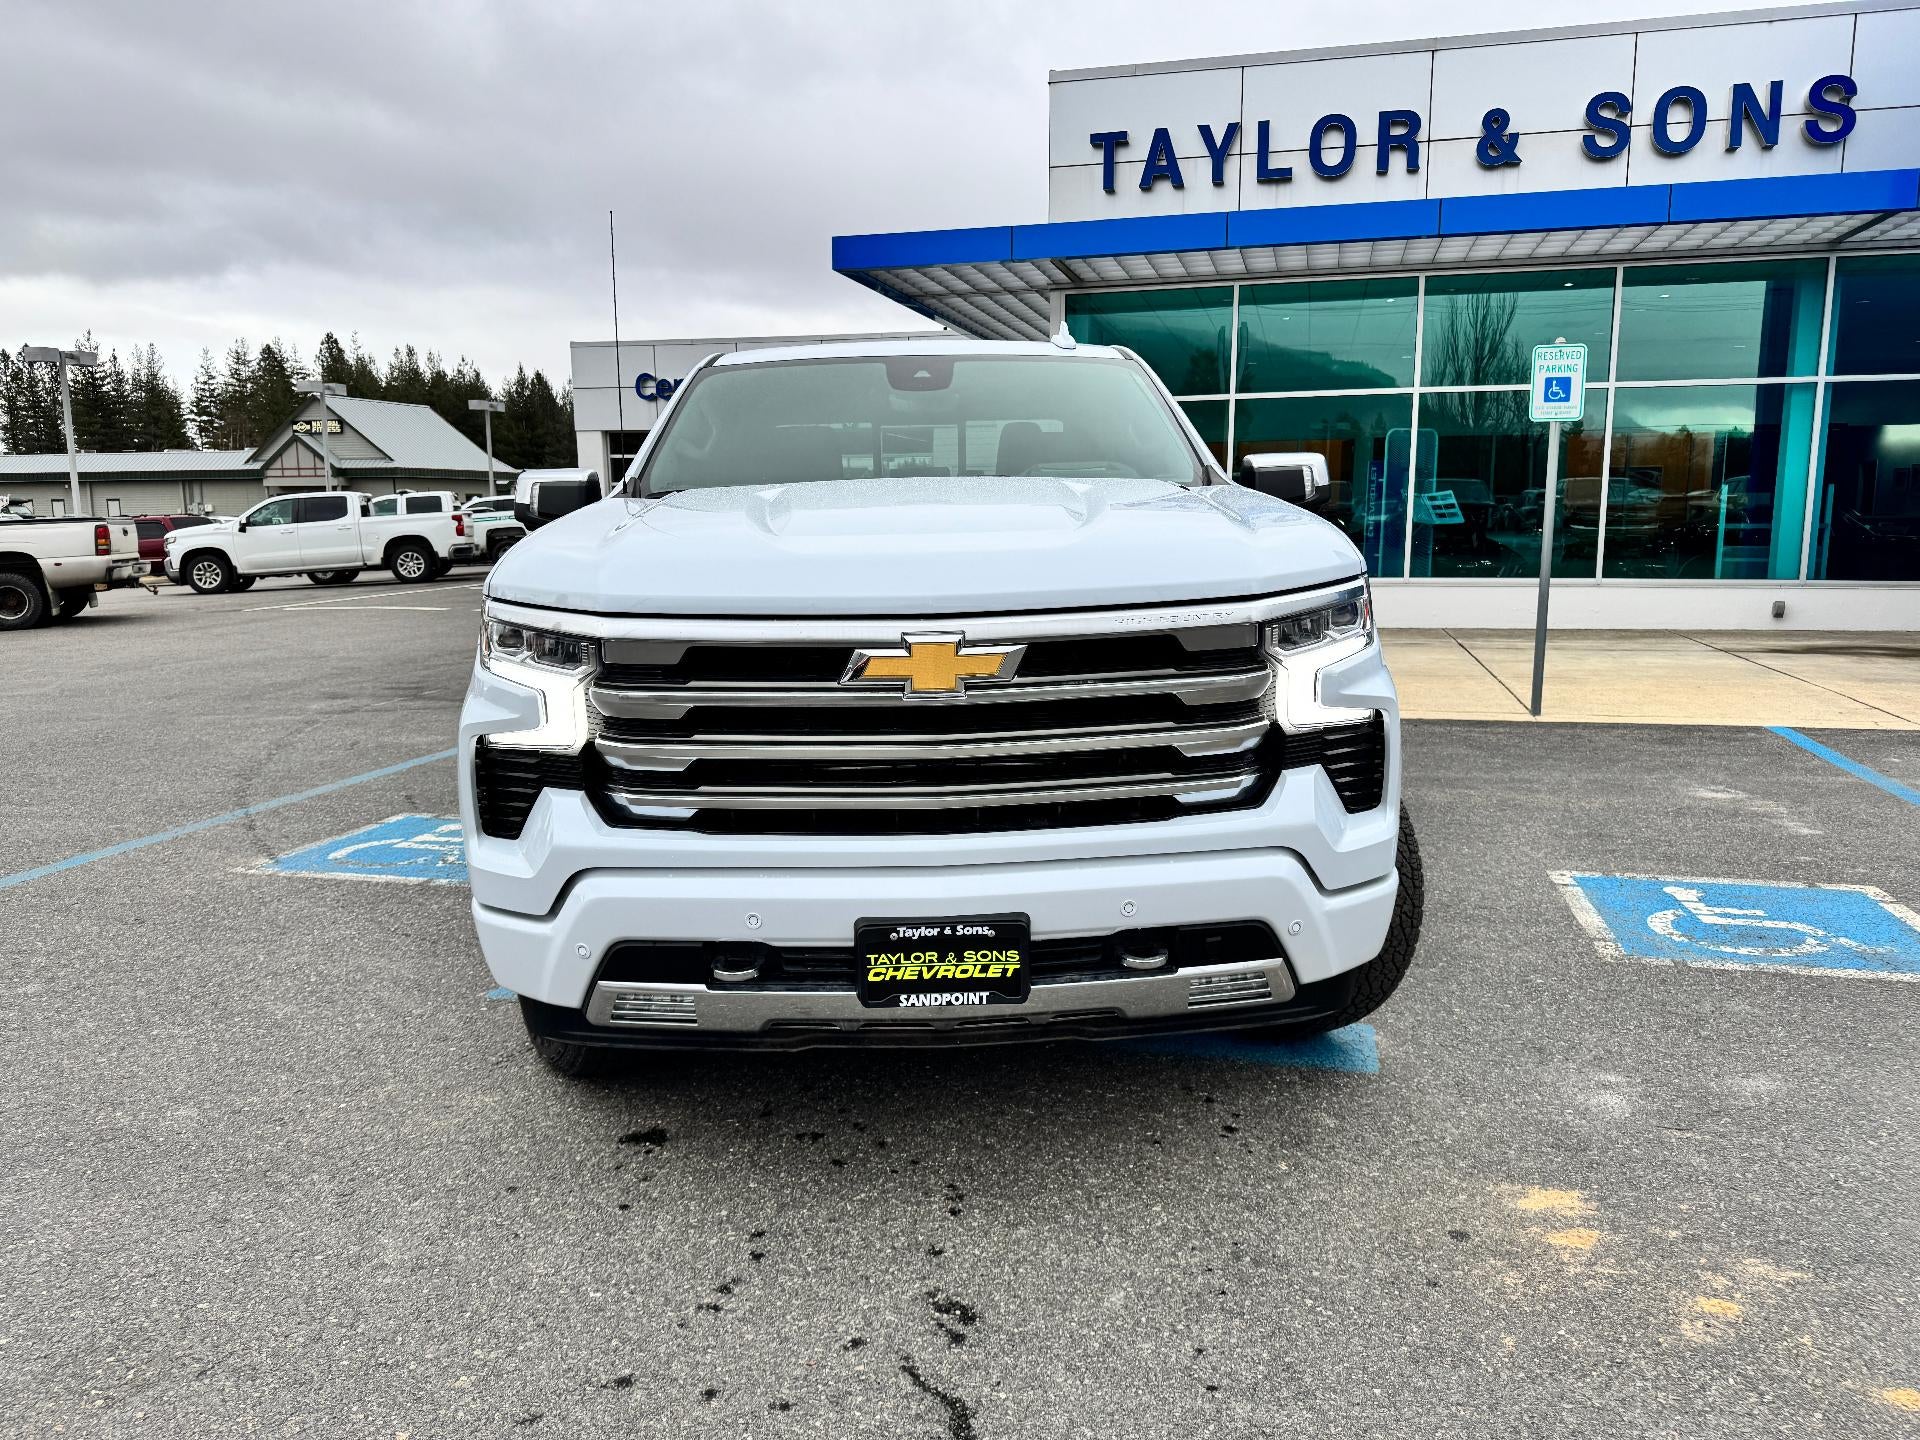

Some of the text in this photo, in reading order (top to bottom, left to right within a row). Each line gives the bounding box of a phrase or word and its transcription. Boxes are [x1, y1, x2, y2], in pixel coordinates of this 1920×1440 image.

[1089, 74, 1859, 193] TAYLOR & SONS
[1537, 351, 1582, 360] RESERVED
[1538, 364, 1578, 374] PARKING
[1367, 467, 1377, 537] CHEVROLET
[896, 924, 989, 940] Taylor & Sons
[866, 950, 1020, 965] TAYLOR & SONS
[867, 964, 1021, 982] CHEVROLET
[899, 992, 990, 1007] SANDPOINT
